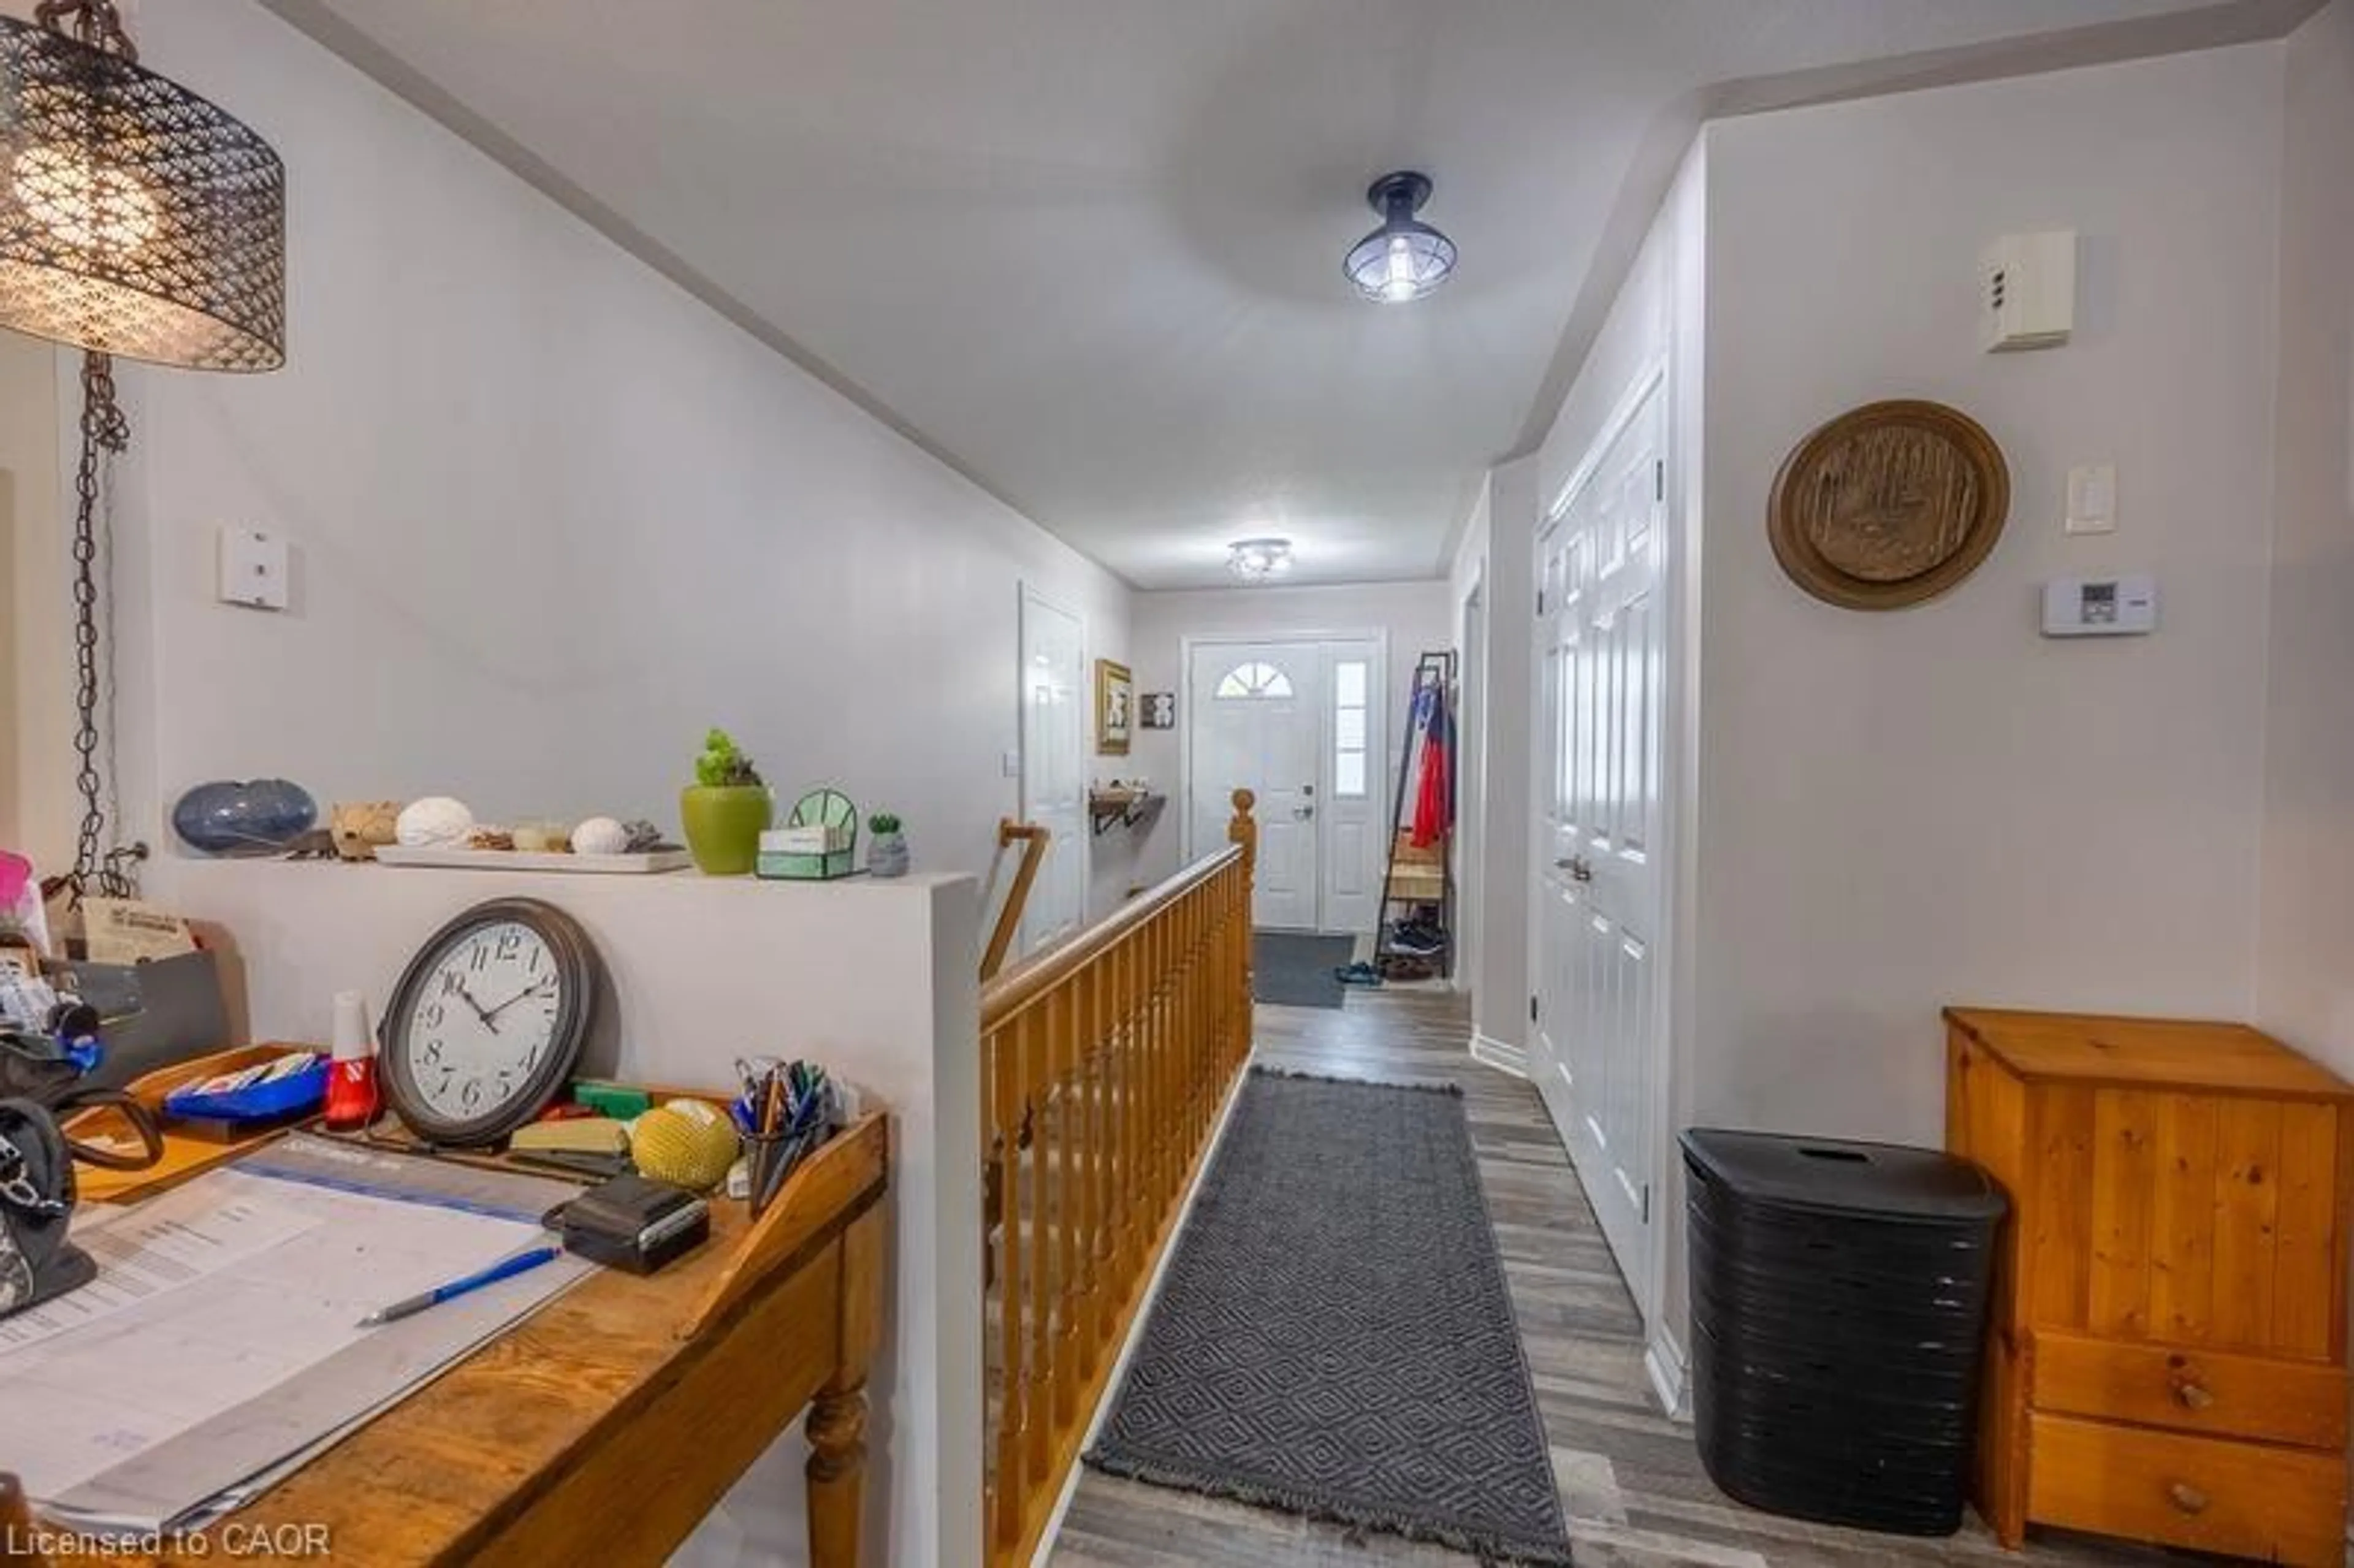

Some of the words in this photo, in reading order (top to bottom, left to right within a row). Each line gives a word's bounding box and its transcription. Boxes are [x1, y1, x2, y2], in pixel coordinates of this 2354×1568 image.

[471, 945, 488, 972] 11
[495, 933, 520, 961] 12
[530, 946, 540, 972] 1
[442, 970, 466, 996] 10
[427, 1002, 444, 1029] 9
[424, 1039, 443, 1067] 8
[518, 1044, 537, 1072] 4
[462, 1079, 480, 1106] 6
